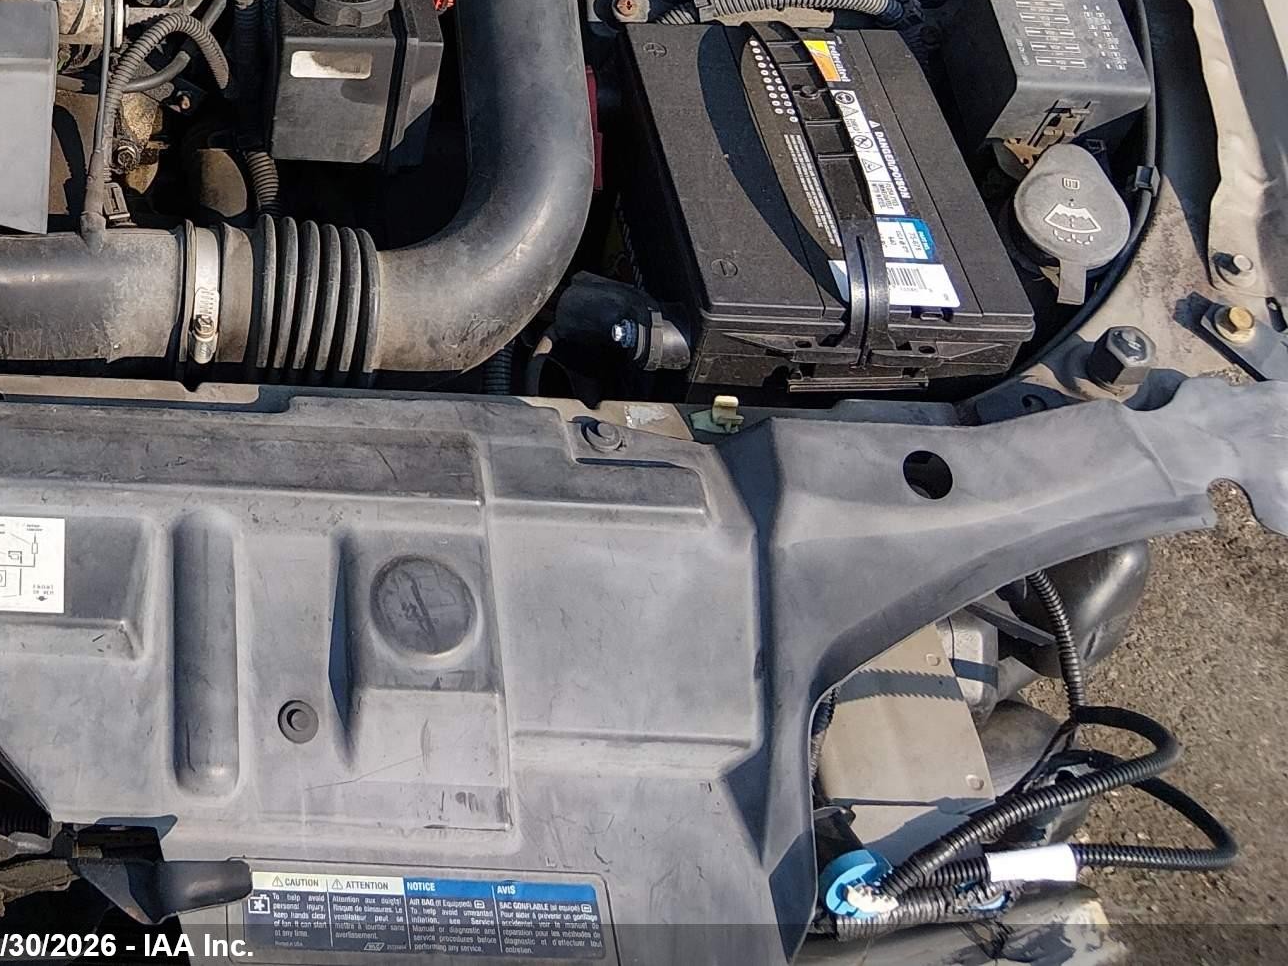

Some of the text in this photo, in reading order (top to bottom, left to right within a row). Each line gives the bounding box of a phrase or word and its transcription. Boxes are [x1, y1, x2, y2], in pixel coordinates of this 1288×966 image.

[827, 40, 851, 82] Federated
[874, 131, 911, 199] DANGER/POISON
[284, 878, 318, 887] CAUTION
[345, 880, 388, 890] ATTENTION
[406, 881, 435, 891] NOTICE
[496, 885, 516, 894] AVIS
